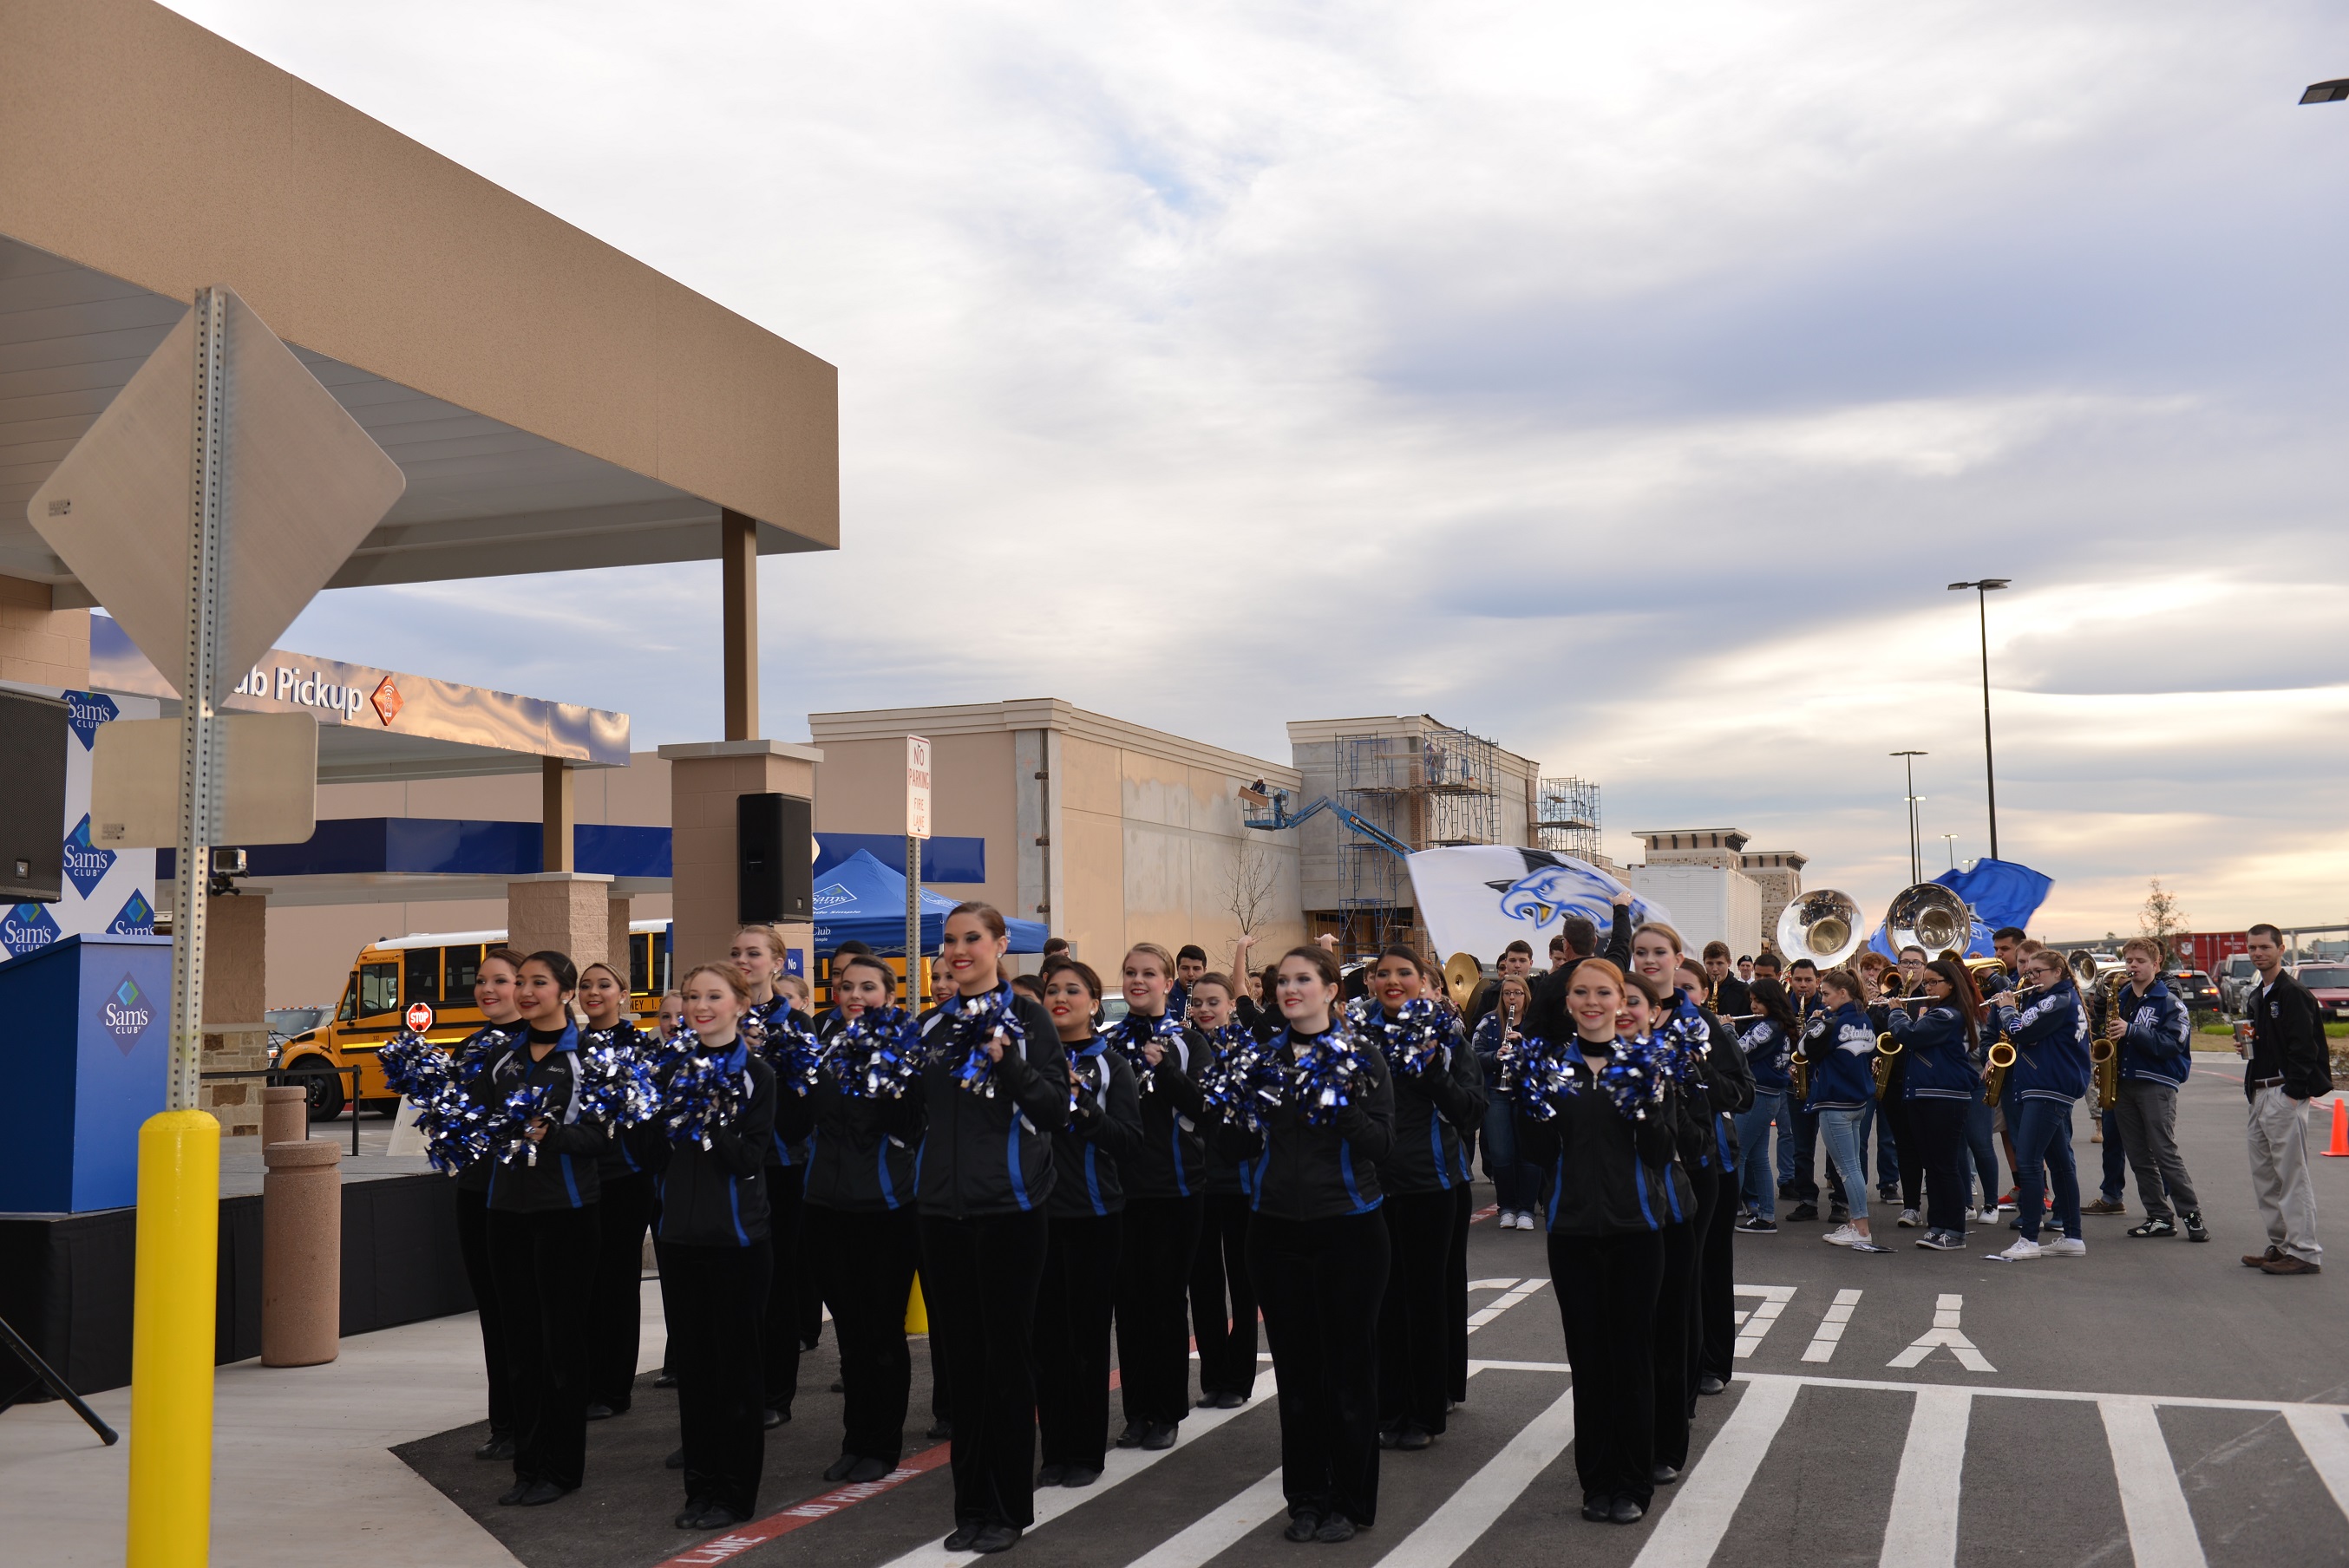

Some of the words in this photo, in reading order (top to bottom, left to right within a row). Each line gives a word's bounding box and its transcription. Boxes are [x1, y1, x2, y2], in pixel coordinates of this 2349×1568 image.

[274, 667, 363, 721] Pickup
[66, 695, 110, 722] Sam's
[913, 747, 925, 767] NO
[908, 768, 930, 790] PARKING
[913, 797, 925, 811] FIRE
[913, 813, 925, 828] LANE
[63, 845, 108, 869] Sam's
[4, 920, 51, 944] Sam's
[788, 958, 797, 970] No
[105, 1003, 148, 1026] Sam's
[410, 1011, 429, 1023] STOP
[1838, 1023, 1875, 1042] Stanley
[676, 1535, 767, 1564] LANE
[782, 1504, 839, 1518] NO
